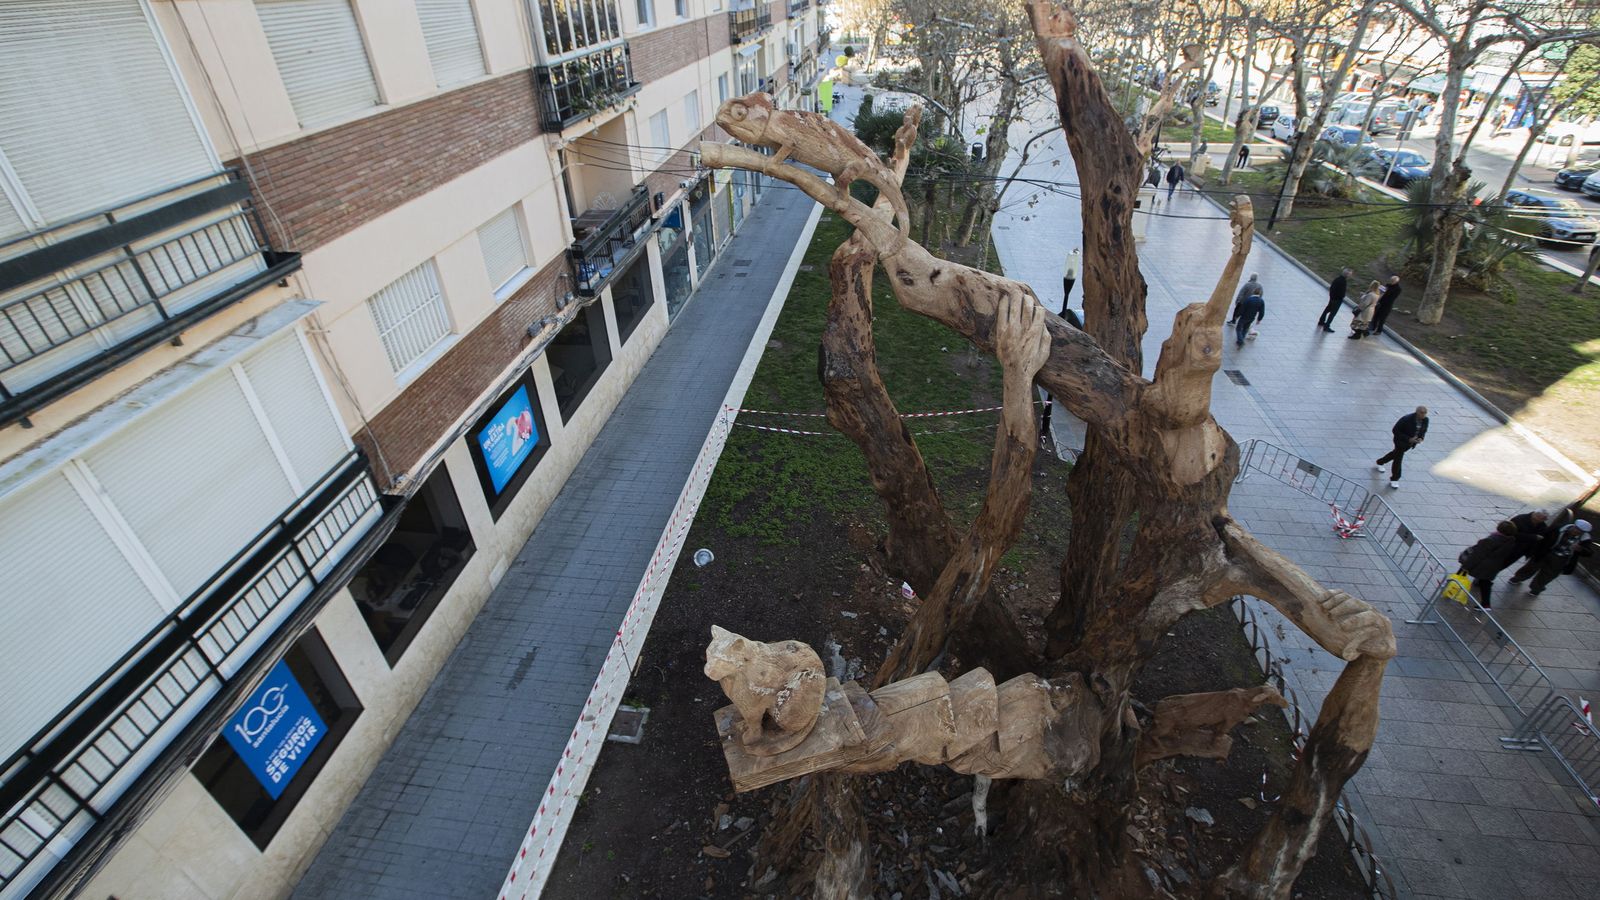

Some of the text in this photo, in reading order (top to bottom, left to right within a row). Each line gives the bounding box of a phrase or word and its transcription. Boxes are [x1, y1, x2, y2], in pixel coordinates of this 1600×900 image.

[265, 717, 312, 775] SEGUROS
[271, 724, 318, 783] DE VIVIR
